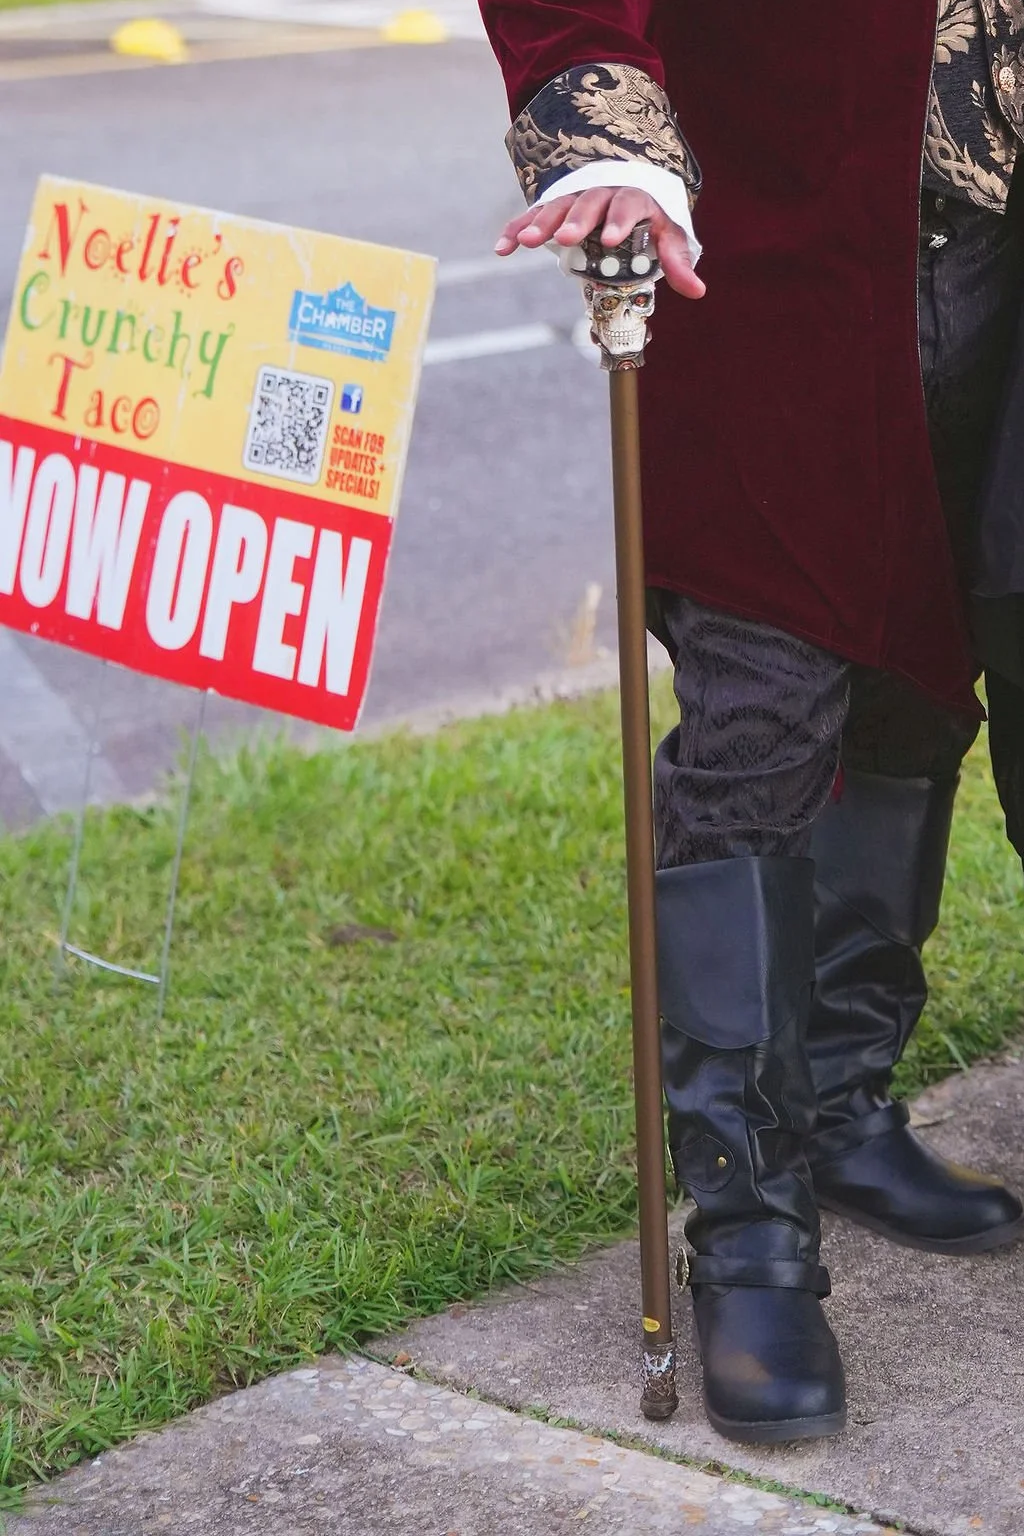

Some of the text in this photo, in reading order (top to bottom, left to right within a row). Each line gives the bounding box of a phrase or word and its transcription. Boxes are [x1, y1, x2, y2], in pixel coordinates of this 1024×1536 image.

[20, 271, 236, 398] Crunchy
[298, 302, 387, 340] CHAMBER
[335, 298, 356, 313] THE
[47, 350, 161, 440] Taco
[325, 469, 380, 500] SPECIALS!
[0, 439, 372, 697] NOW OPEN
